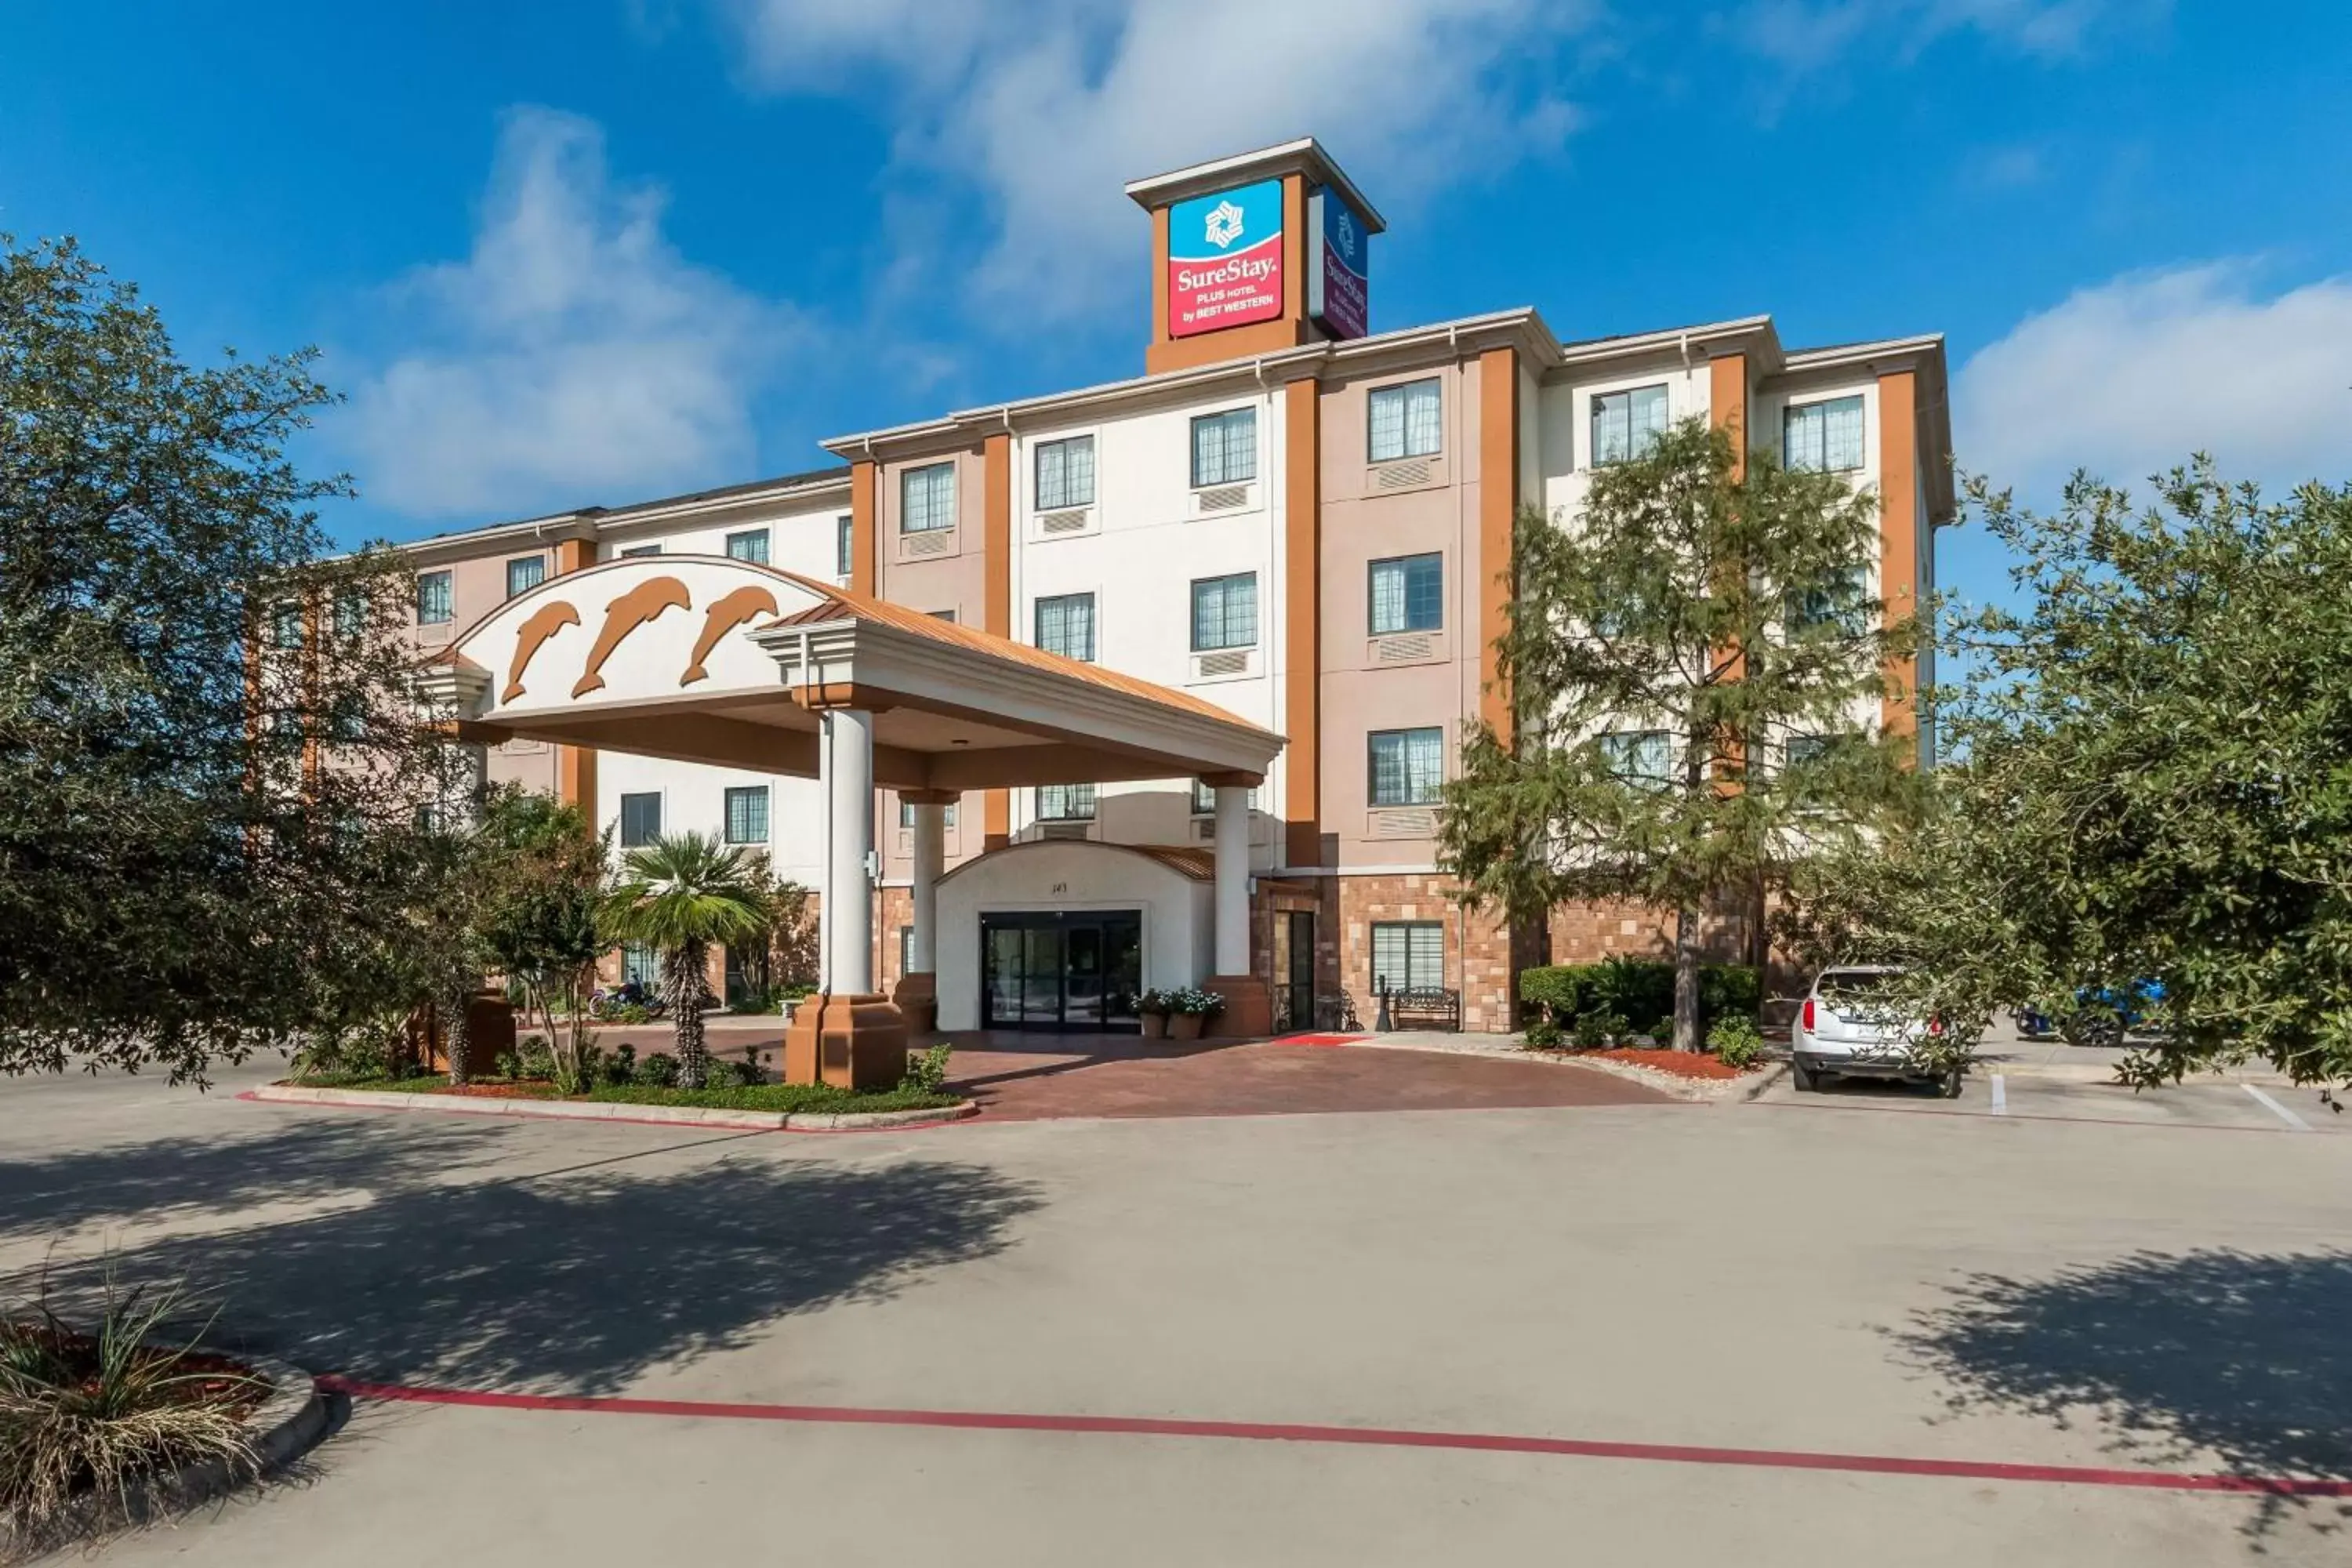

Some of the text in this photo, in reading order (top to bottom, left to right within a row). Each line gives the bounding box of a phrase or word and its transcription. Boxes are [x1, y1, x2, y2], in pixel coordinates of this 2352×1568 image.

[1196, 285, 1257, 304] PLUS HOTEL
[1182, 295, 1274, 323] by BEST WESTERN
